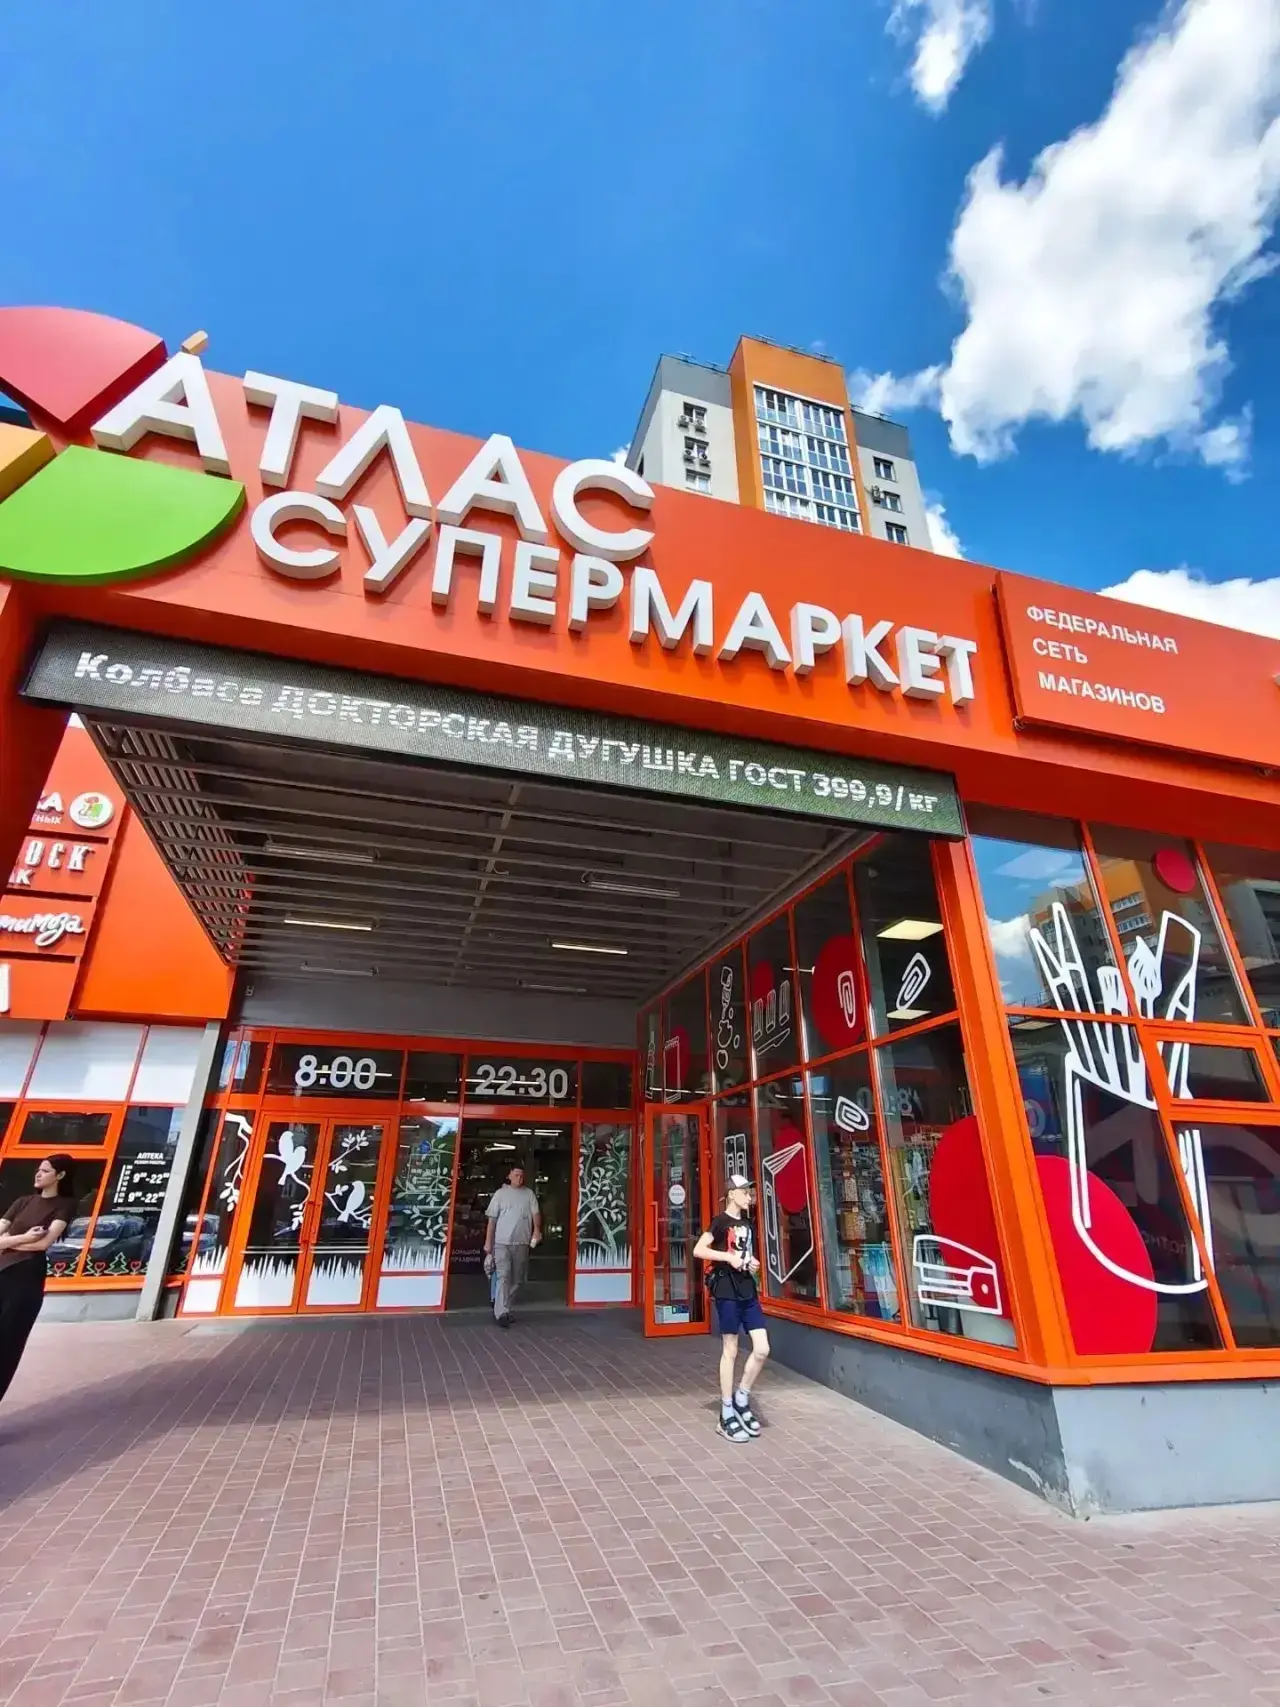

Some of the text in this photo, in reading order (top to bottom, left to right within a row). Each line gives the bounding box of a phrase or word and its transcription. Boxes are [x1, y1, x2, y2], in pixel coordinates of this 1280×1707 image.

[91, 351, 655, 562] АТЛАС
[251, 490, 978, 707] СУПЕРМАРКЕТ
[1026, 605, 1179, 654] ФЕДЕРАЛЬНАЯ
[1032, 637, 1089, 664] СЕТЬ
[1038, 671, 1166, 714] МАГАЗИНОВ
[271, 685, 538, 752] ДОКТОРСКАЯ
[547, 730, 720, 780] ДУГУШКА
[728, 758, 807, 792] ГОСТ
[33, 814, 62, 824] НЫХ
[295, 1054, 377, 1090] 8:00
[475, 1064, 568, 1098] 22:30
